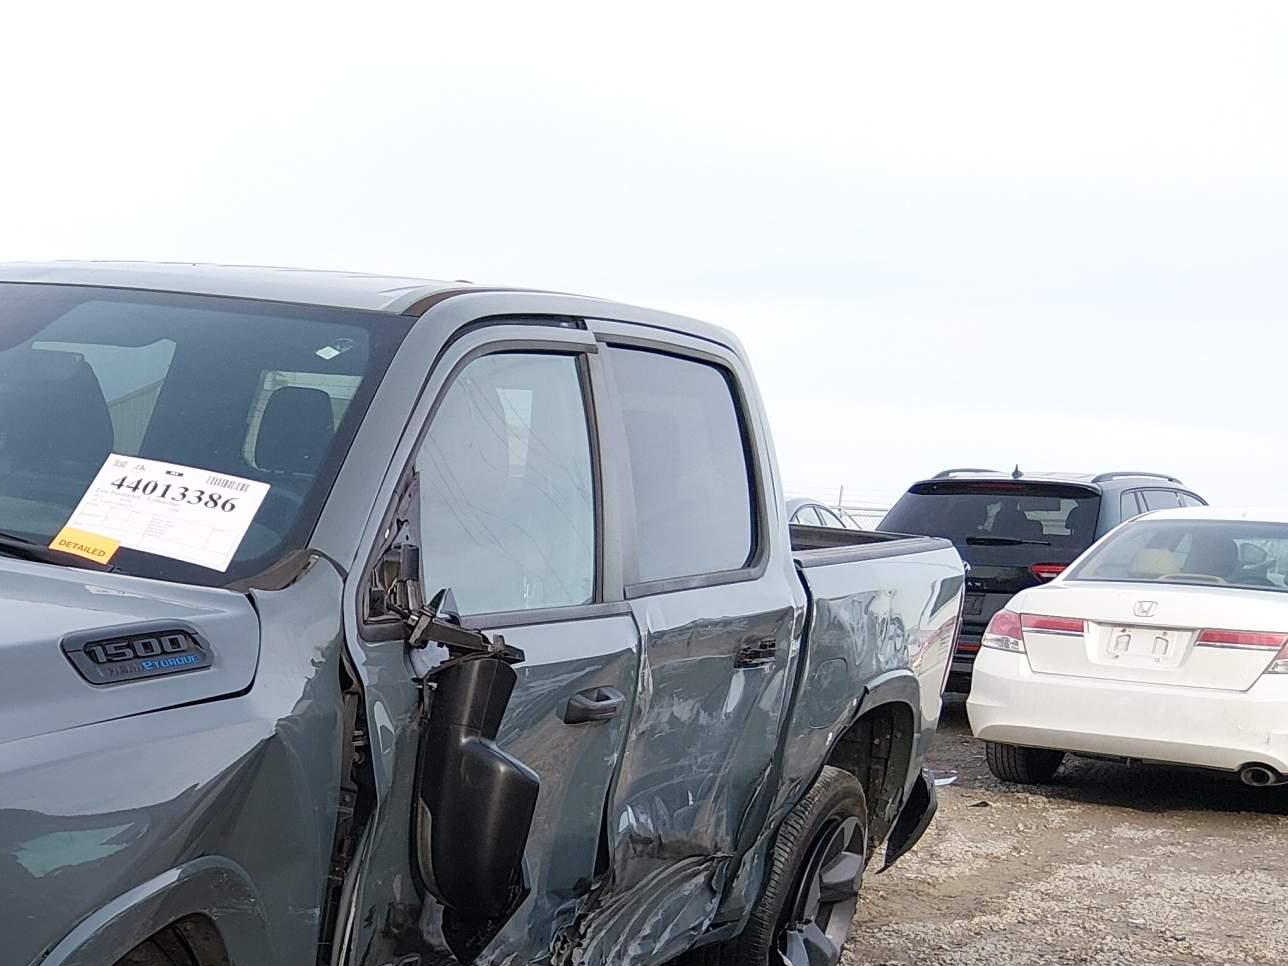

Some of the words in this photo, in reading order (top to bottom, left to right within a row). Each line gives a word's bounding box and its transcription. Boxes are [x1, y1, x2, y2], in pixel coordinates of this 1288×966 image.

[110, 475, 241, 513] 44013386
[58, 538, 106, 558] DETAILED
[89, 634, 189, 663] 1500
